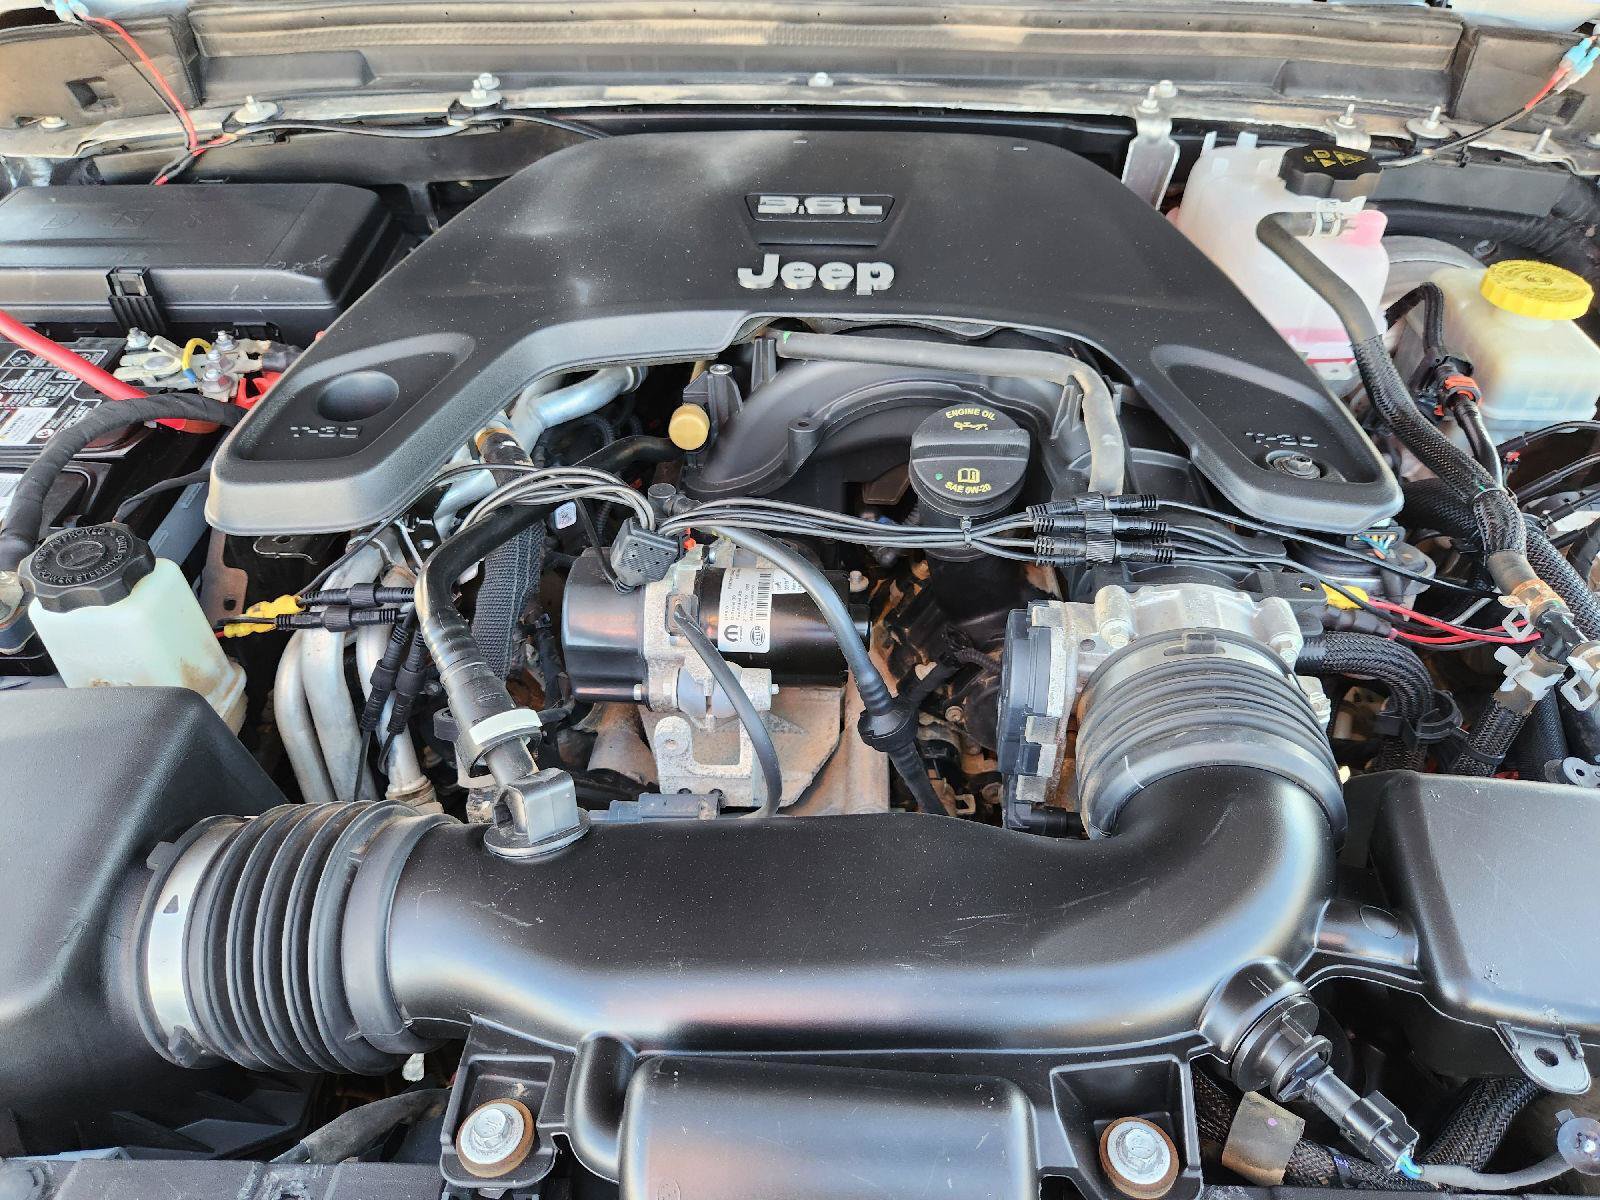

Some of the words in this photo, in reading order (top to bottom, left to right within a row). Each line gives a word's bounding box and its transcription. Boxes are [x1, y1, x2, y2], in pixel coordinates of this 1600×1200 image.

[757, 196, 883, 214] 3.6L
[737, 253, 895, 295] Jeep
[945, 408, 981, 419] ENGINE
[981, 409, 997, 421] OIL
[945, 481, 964, 494] SAE
[965, 483, 992, 495] 0W-20
